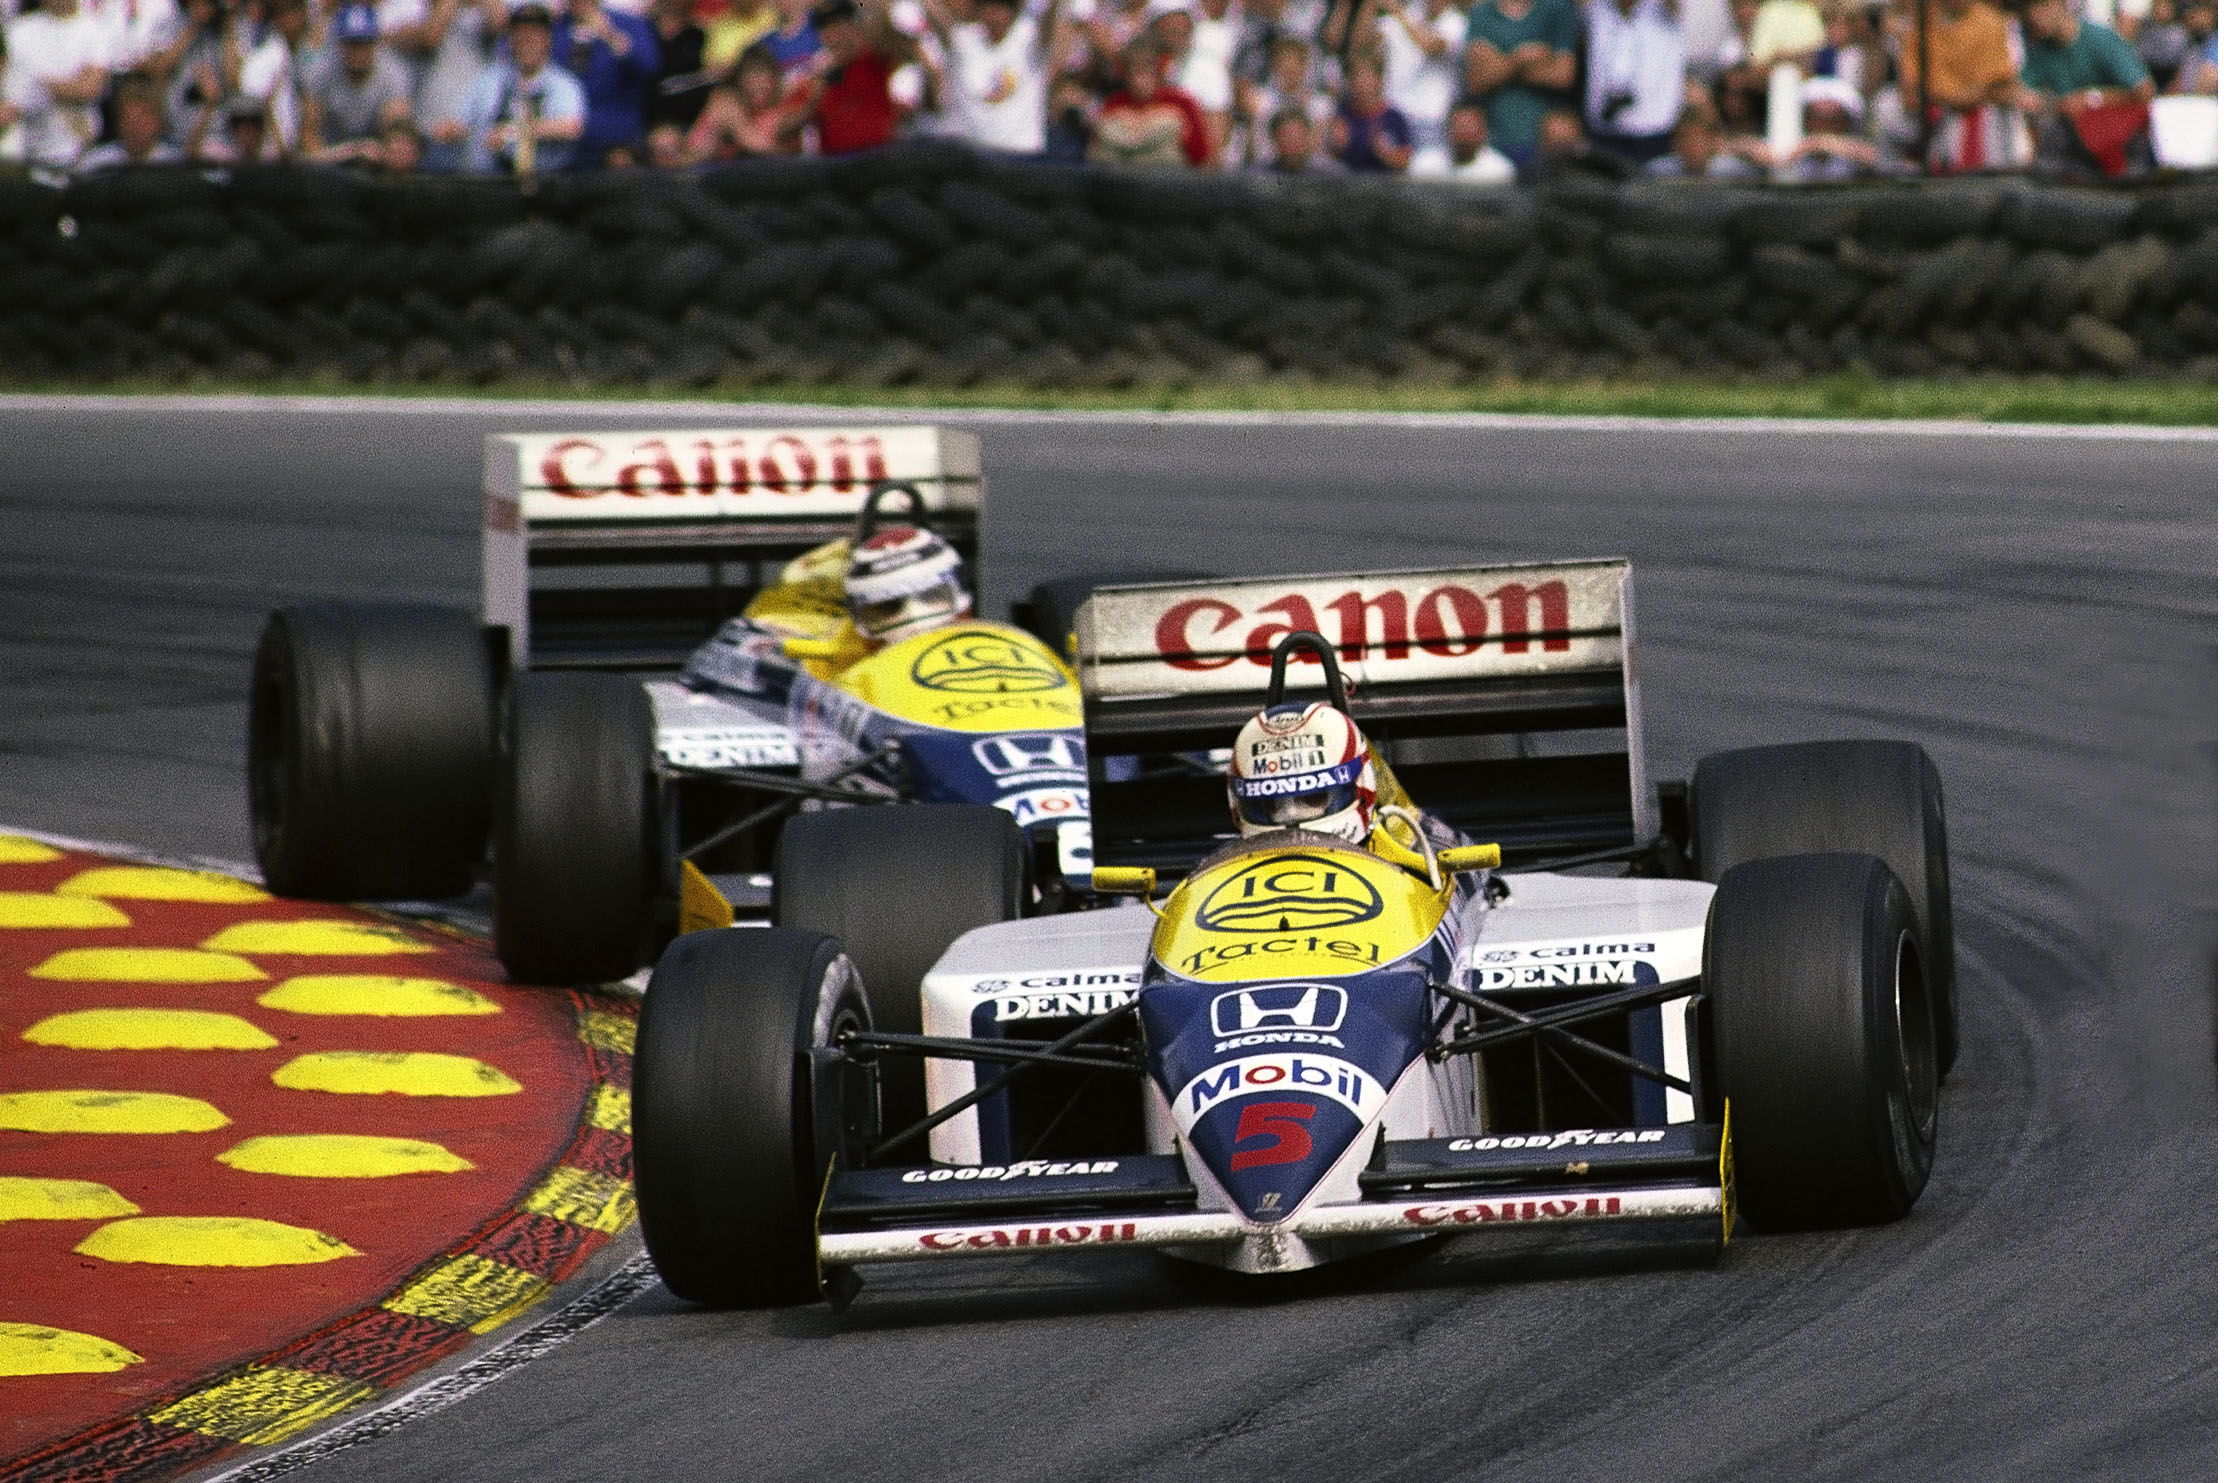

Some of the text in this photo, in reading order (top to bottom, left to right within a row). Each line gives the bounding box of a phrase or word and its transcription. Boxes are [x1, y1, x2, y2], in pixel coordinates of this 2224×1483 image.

[539, 434, 888, 499] Canon
[1154, 579, 1571, 672] Canon
[1253, 753, 1303, 775] Mobil
[1245, 771, 1337, 797] HONDA
[1242, 871, 1338, 898] ICI
[1181, 936, 1381, 973] Tactel
[1528, 941, 1656, 959] calma
[1020, 973, 1141, 988] calma
[1478, 960, 1636, 990] DENIM
[1213, 1032, 1345, 1054] HONDA
[1190, 1059, 1363, 1114] Mobil
[1229, 1101, 1317, 1173] 5
[1447, 1129, 1666, 1151] GOODYEAR
[902, 1160, 1120, 1183] GOODYEAR
[1403, 1197, 1621, 1226] Canon
[918, 1222, 1137, 1251] Canon
